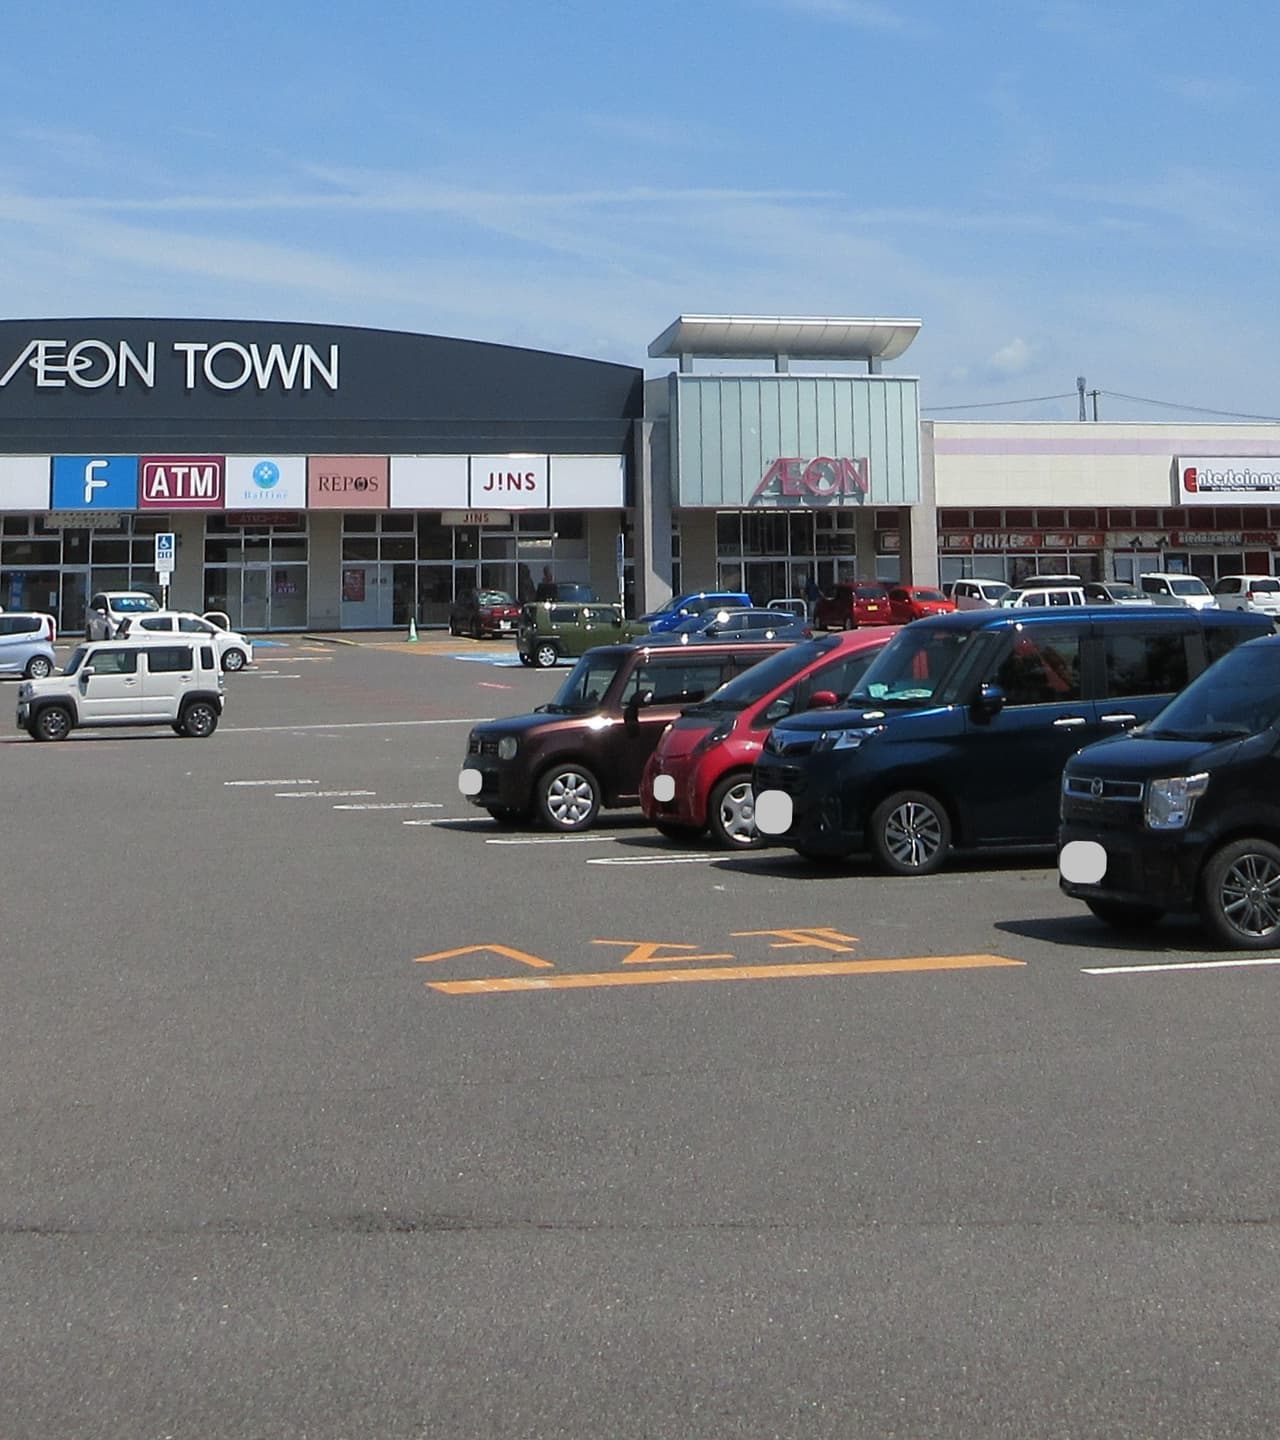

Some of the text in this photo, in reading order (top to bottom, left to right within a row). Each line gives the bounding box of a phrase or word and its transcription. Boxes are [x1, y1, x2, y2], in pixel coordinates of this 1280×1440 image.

[174, 341, 338, 390] TOWN
[149, 466, 213, 497] ATM
[973, 533, 1019, 549] PRIZE
